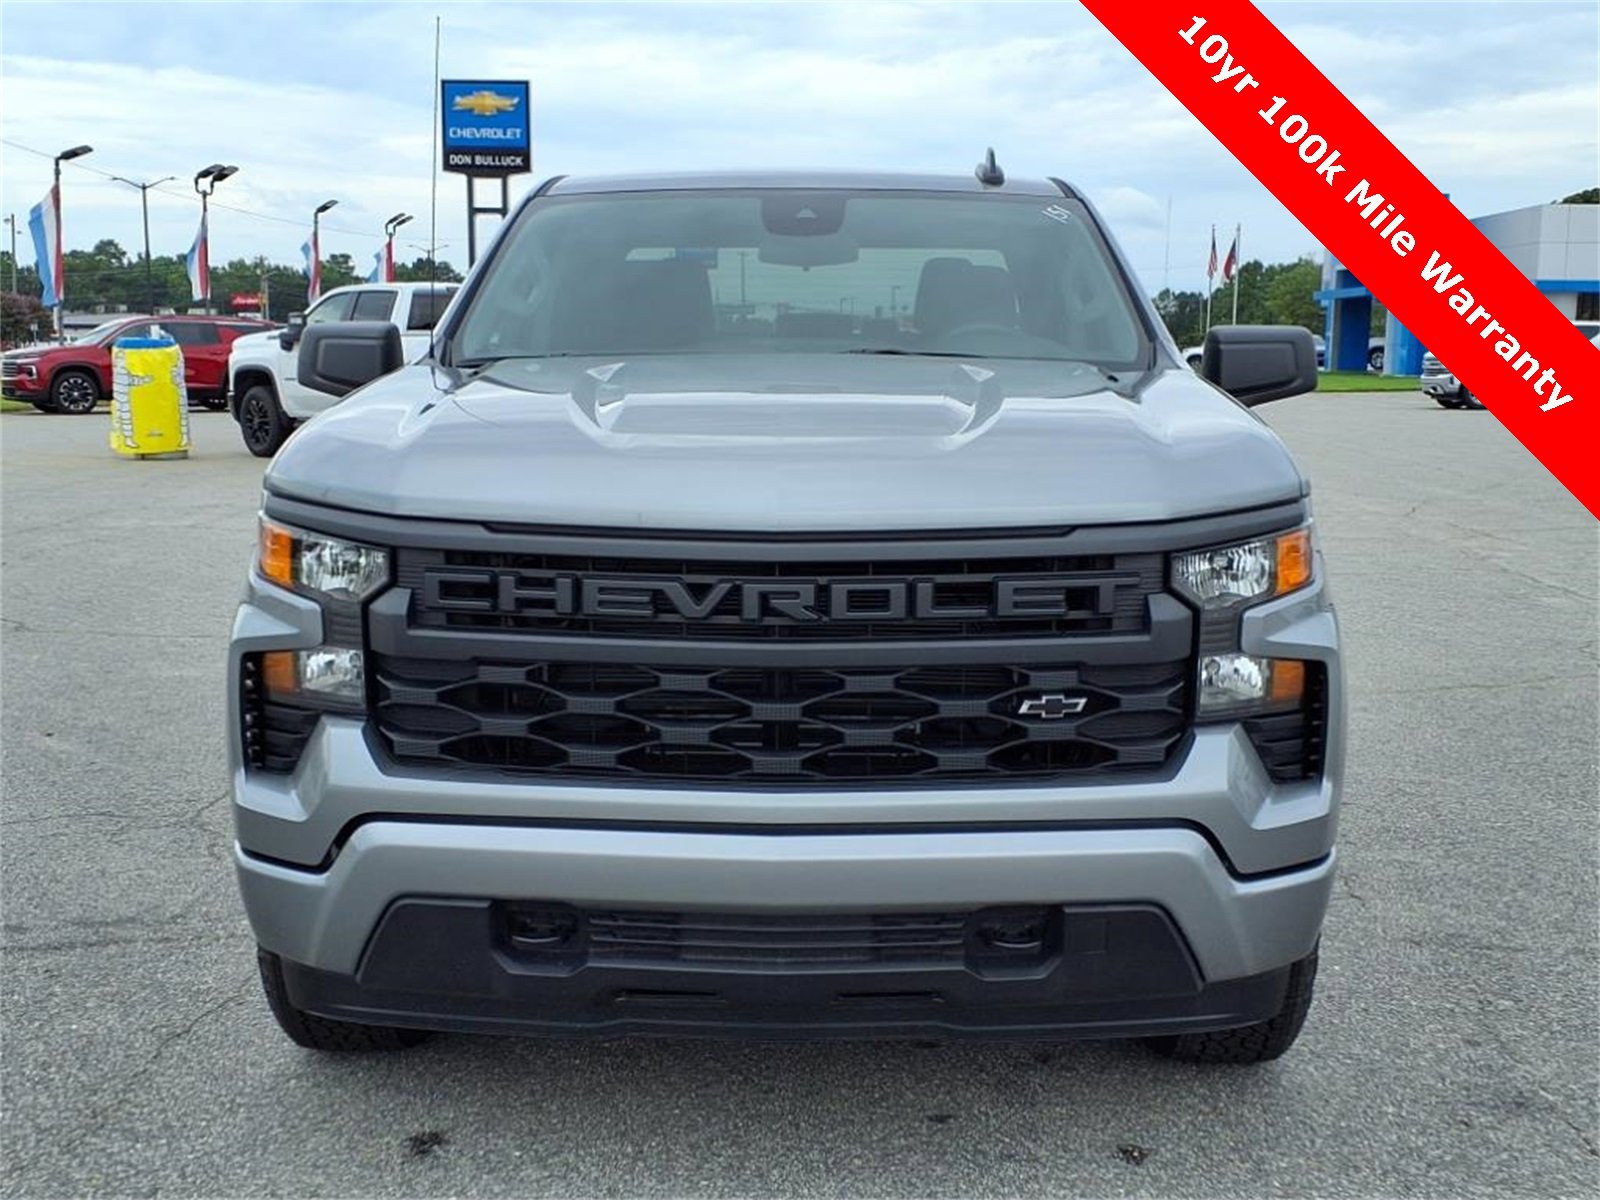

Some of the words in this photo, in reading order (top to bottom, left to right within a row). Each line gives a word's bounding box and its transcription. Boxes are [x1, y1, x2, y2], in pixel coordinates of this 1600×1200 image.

[449, 127, 522, 139] CHEVROLET
[449, 154, 472, 165] DON
[474, 155, 523, 166] BULLUCK
[424, 571, 1140, 622] CHEVROLET
